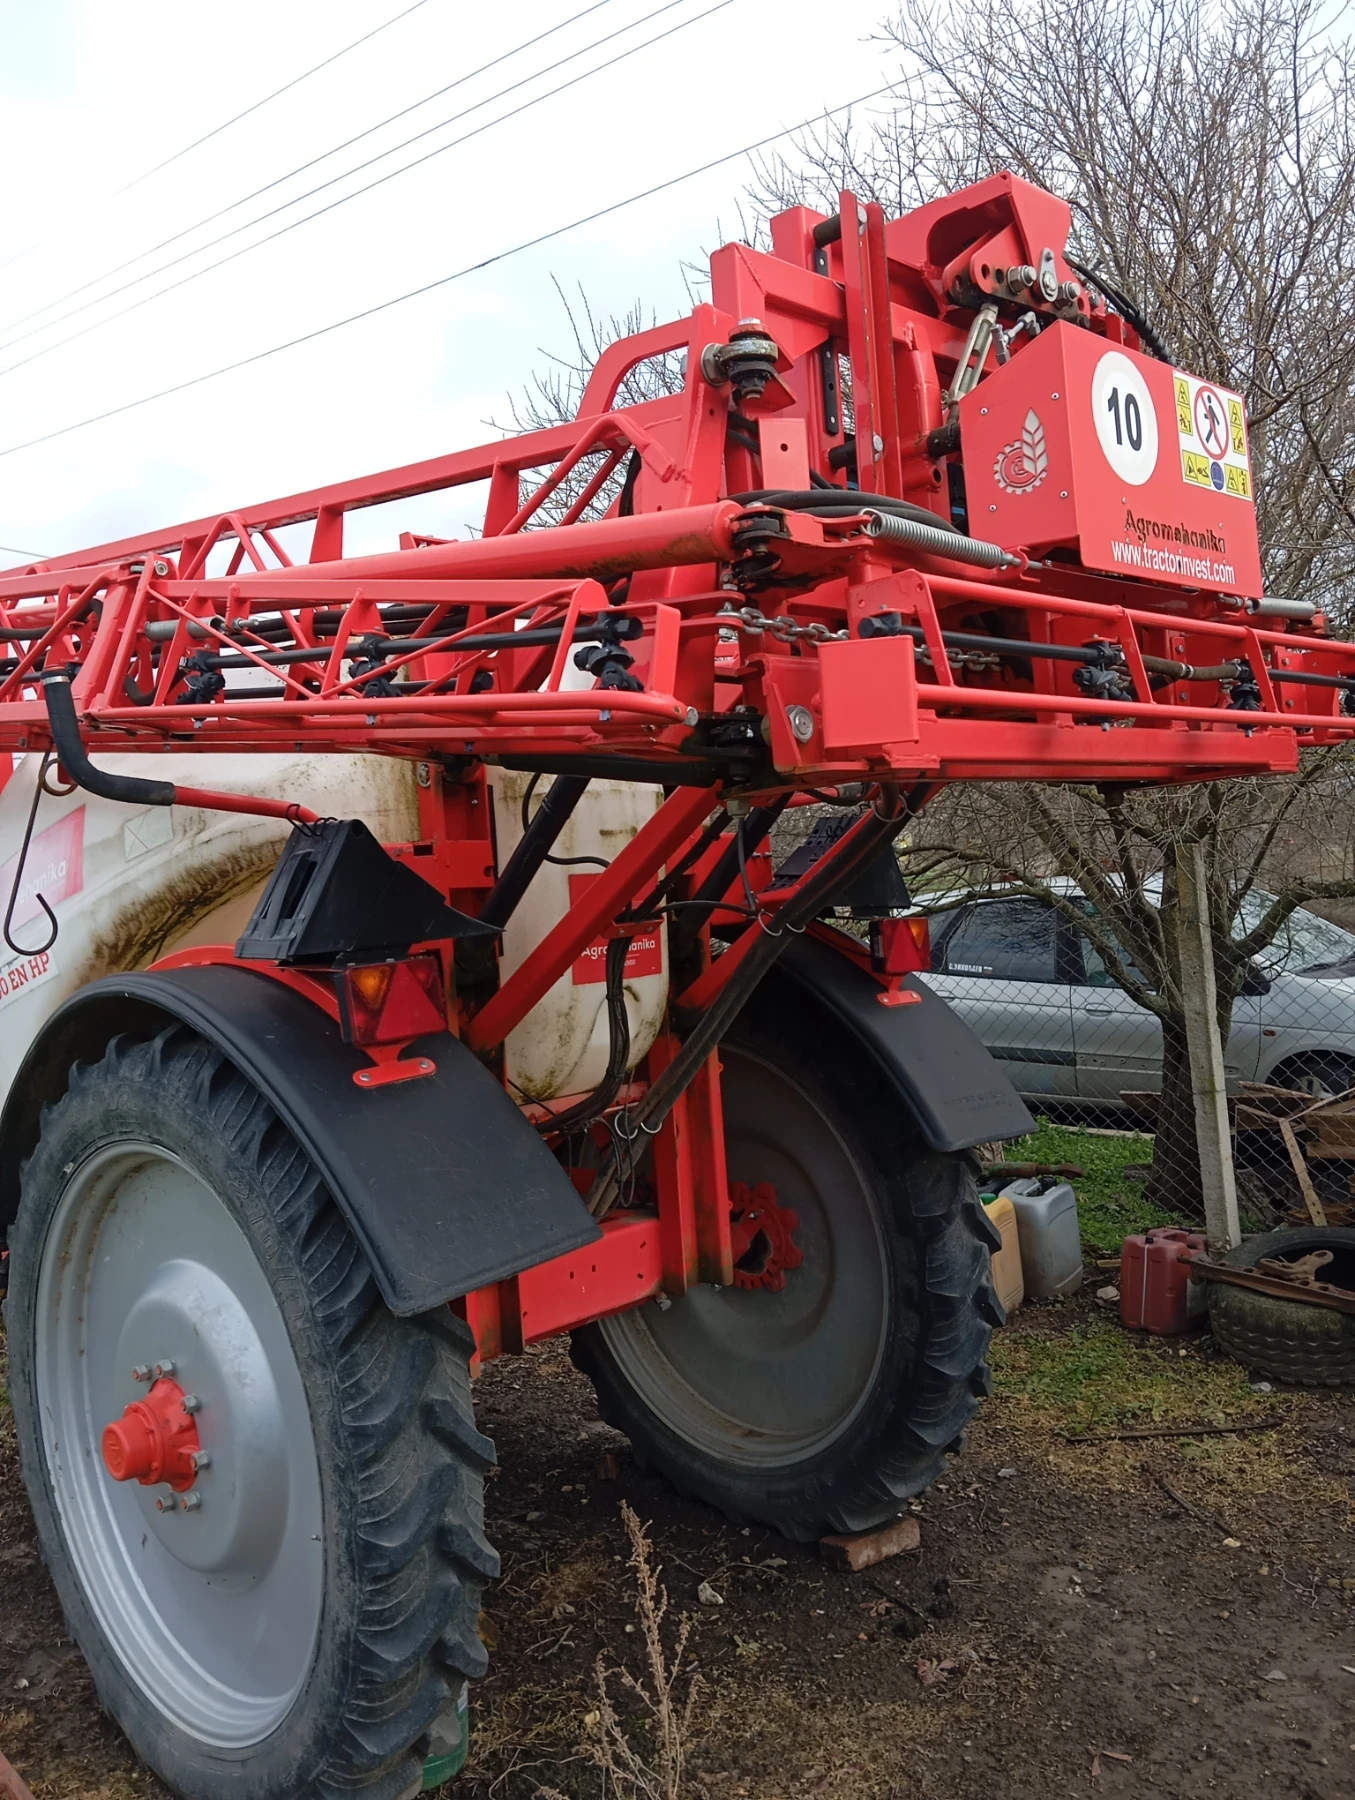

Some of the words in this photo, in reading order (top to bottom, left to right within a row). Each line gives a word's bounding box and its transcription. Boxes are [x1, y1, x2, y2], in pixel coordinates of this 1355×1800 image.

[1108, 386, 1142, 452] 10
[1111, 540, 1236, 585] www.tractorinvest.com
[581, 938, 655, 960] Agroanika
[8, 963, 29, 991] EN
[28, 951, 49, 979] HP
